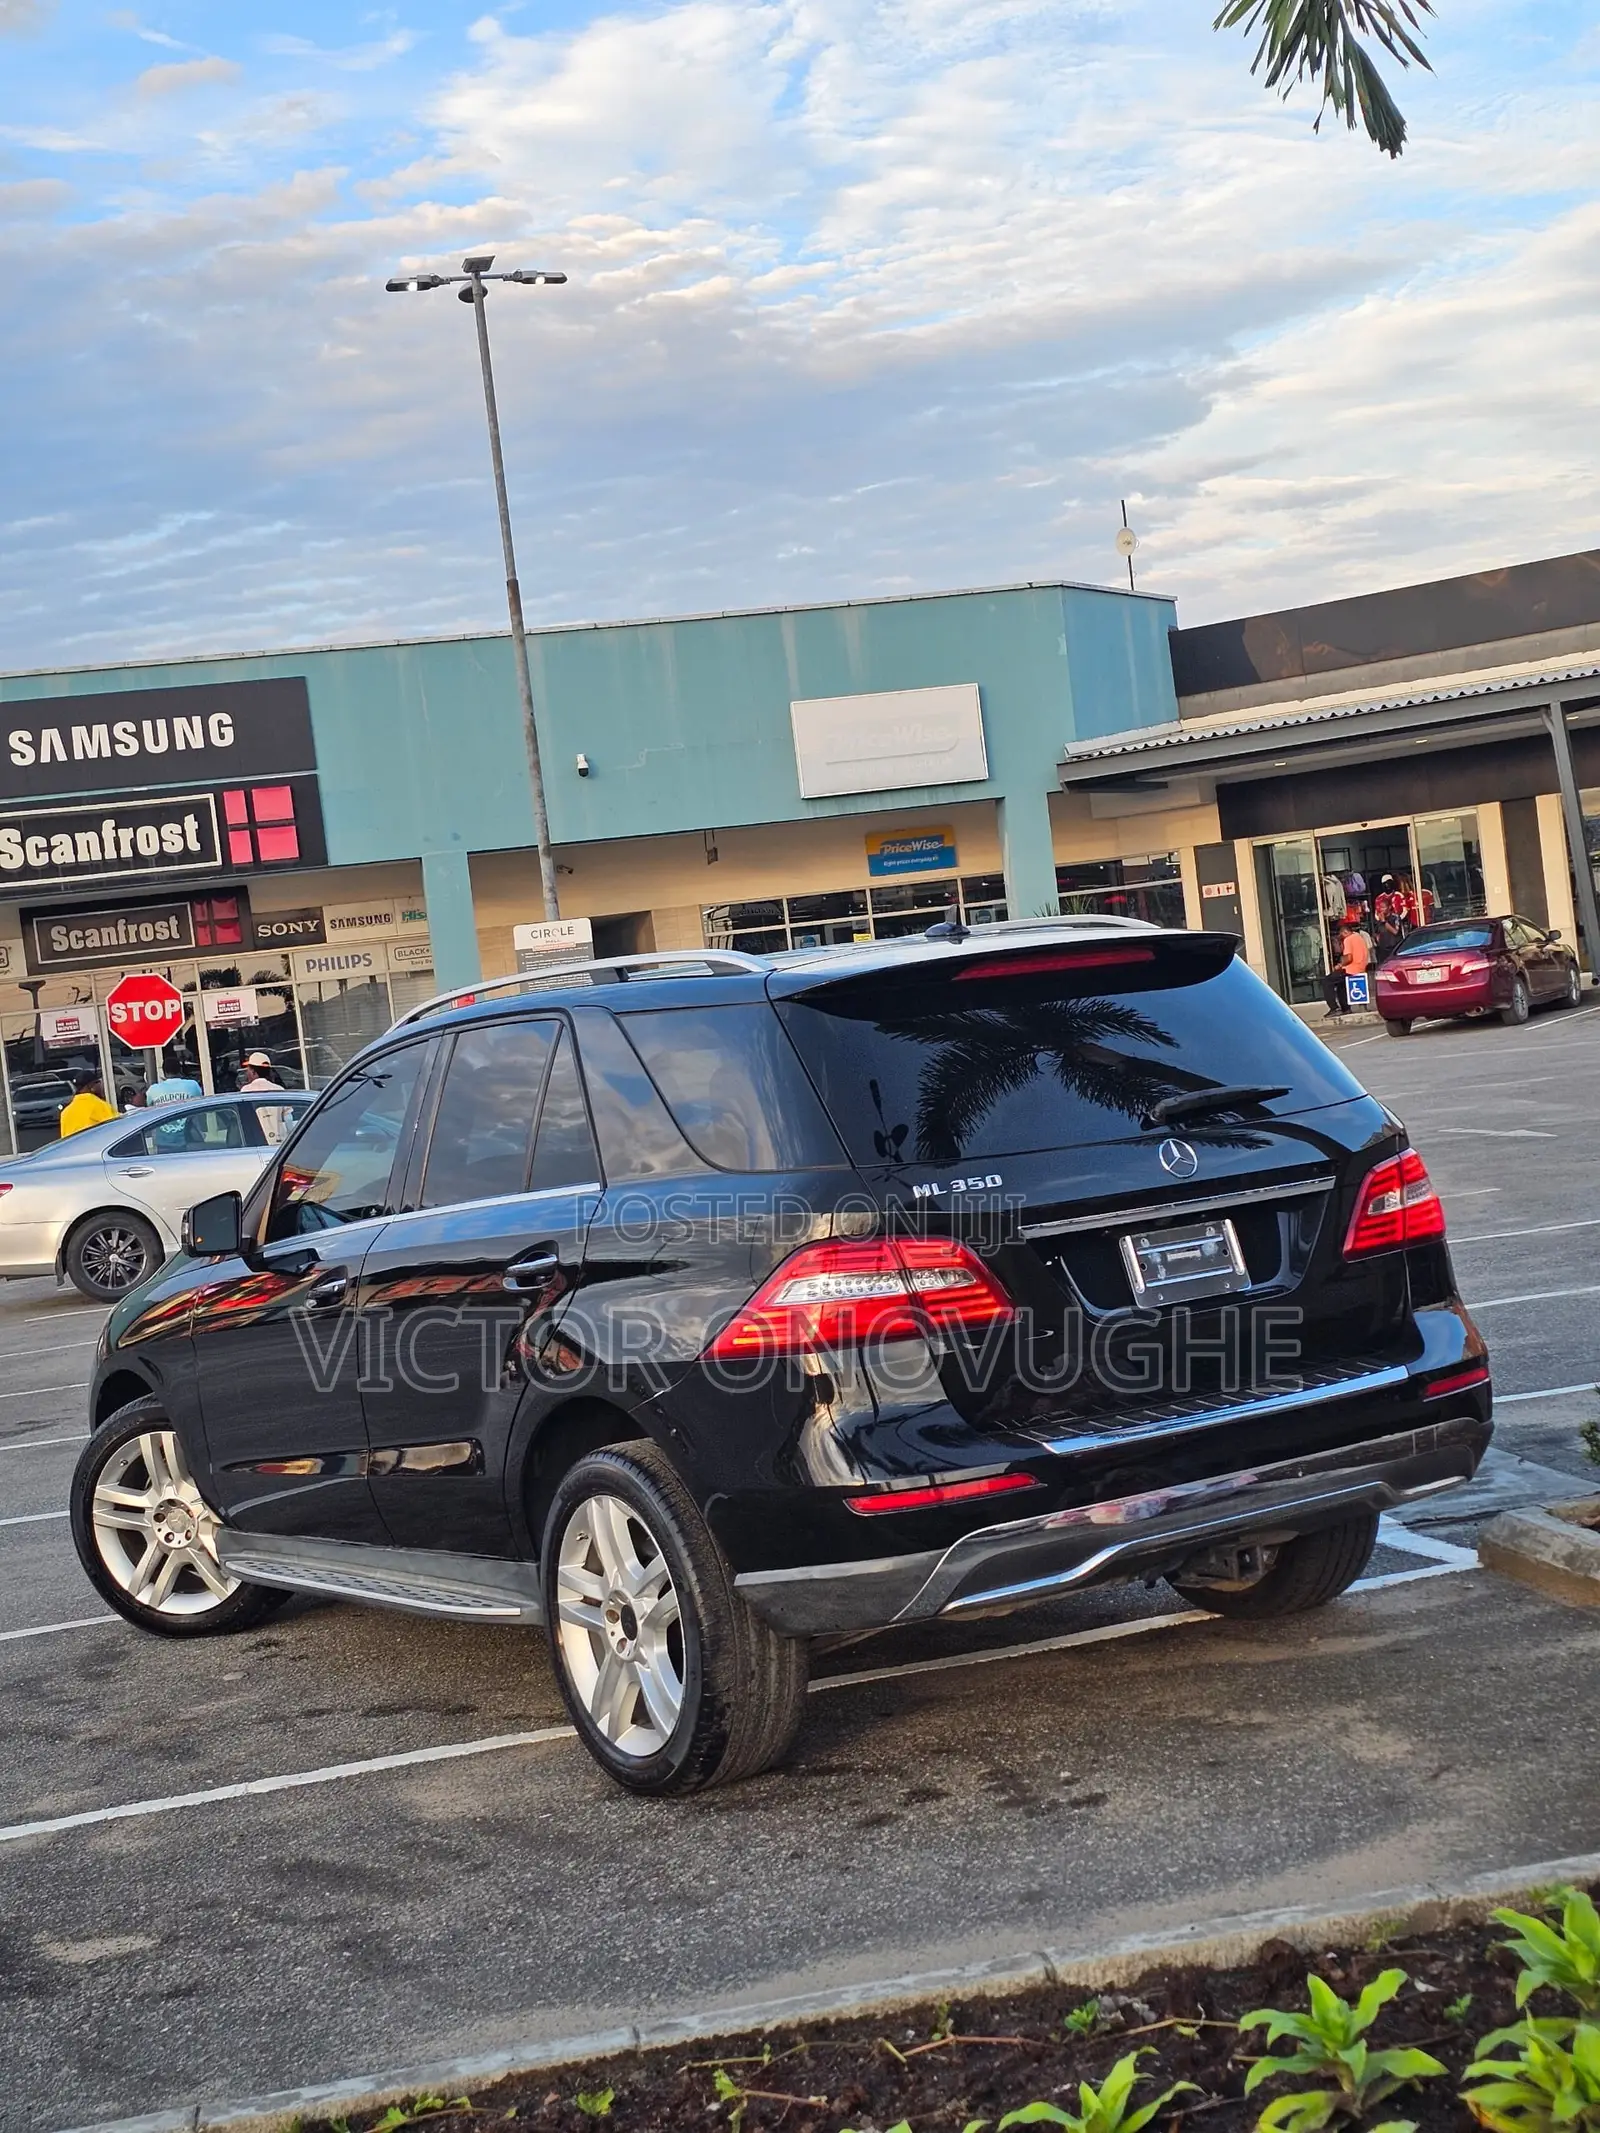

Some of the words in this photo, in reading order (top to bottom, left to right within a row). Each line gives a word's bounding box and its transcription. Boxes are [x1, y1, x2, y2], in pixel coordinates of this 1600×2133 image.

[8, 712, 235, 766] SAMSUNG
[0, 813, 201, 870] Scanfrost
[882, 840, 943, 856] PriceWise
[257, 919, 320, 938] SONY
[330, 913, 393, 930] SAMSUNG
[50, 914, 181, 952] Scanfrost
[530, 926, 575, 939] CIRCLE
[305, 953, 373, 973] PHILIPS
[111, 999, 181, 1023] STOP
[949, 1174, 1003, 1192] 350
